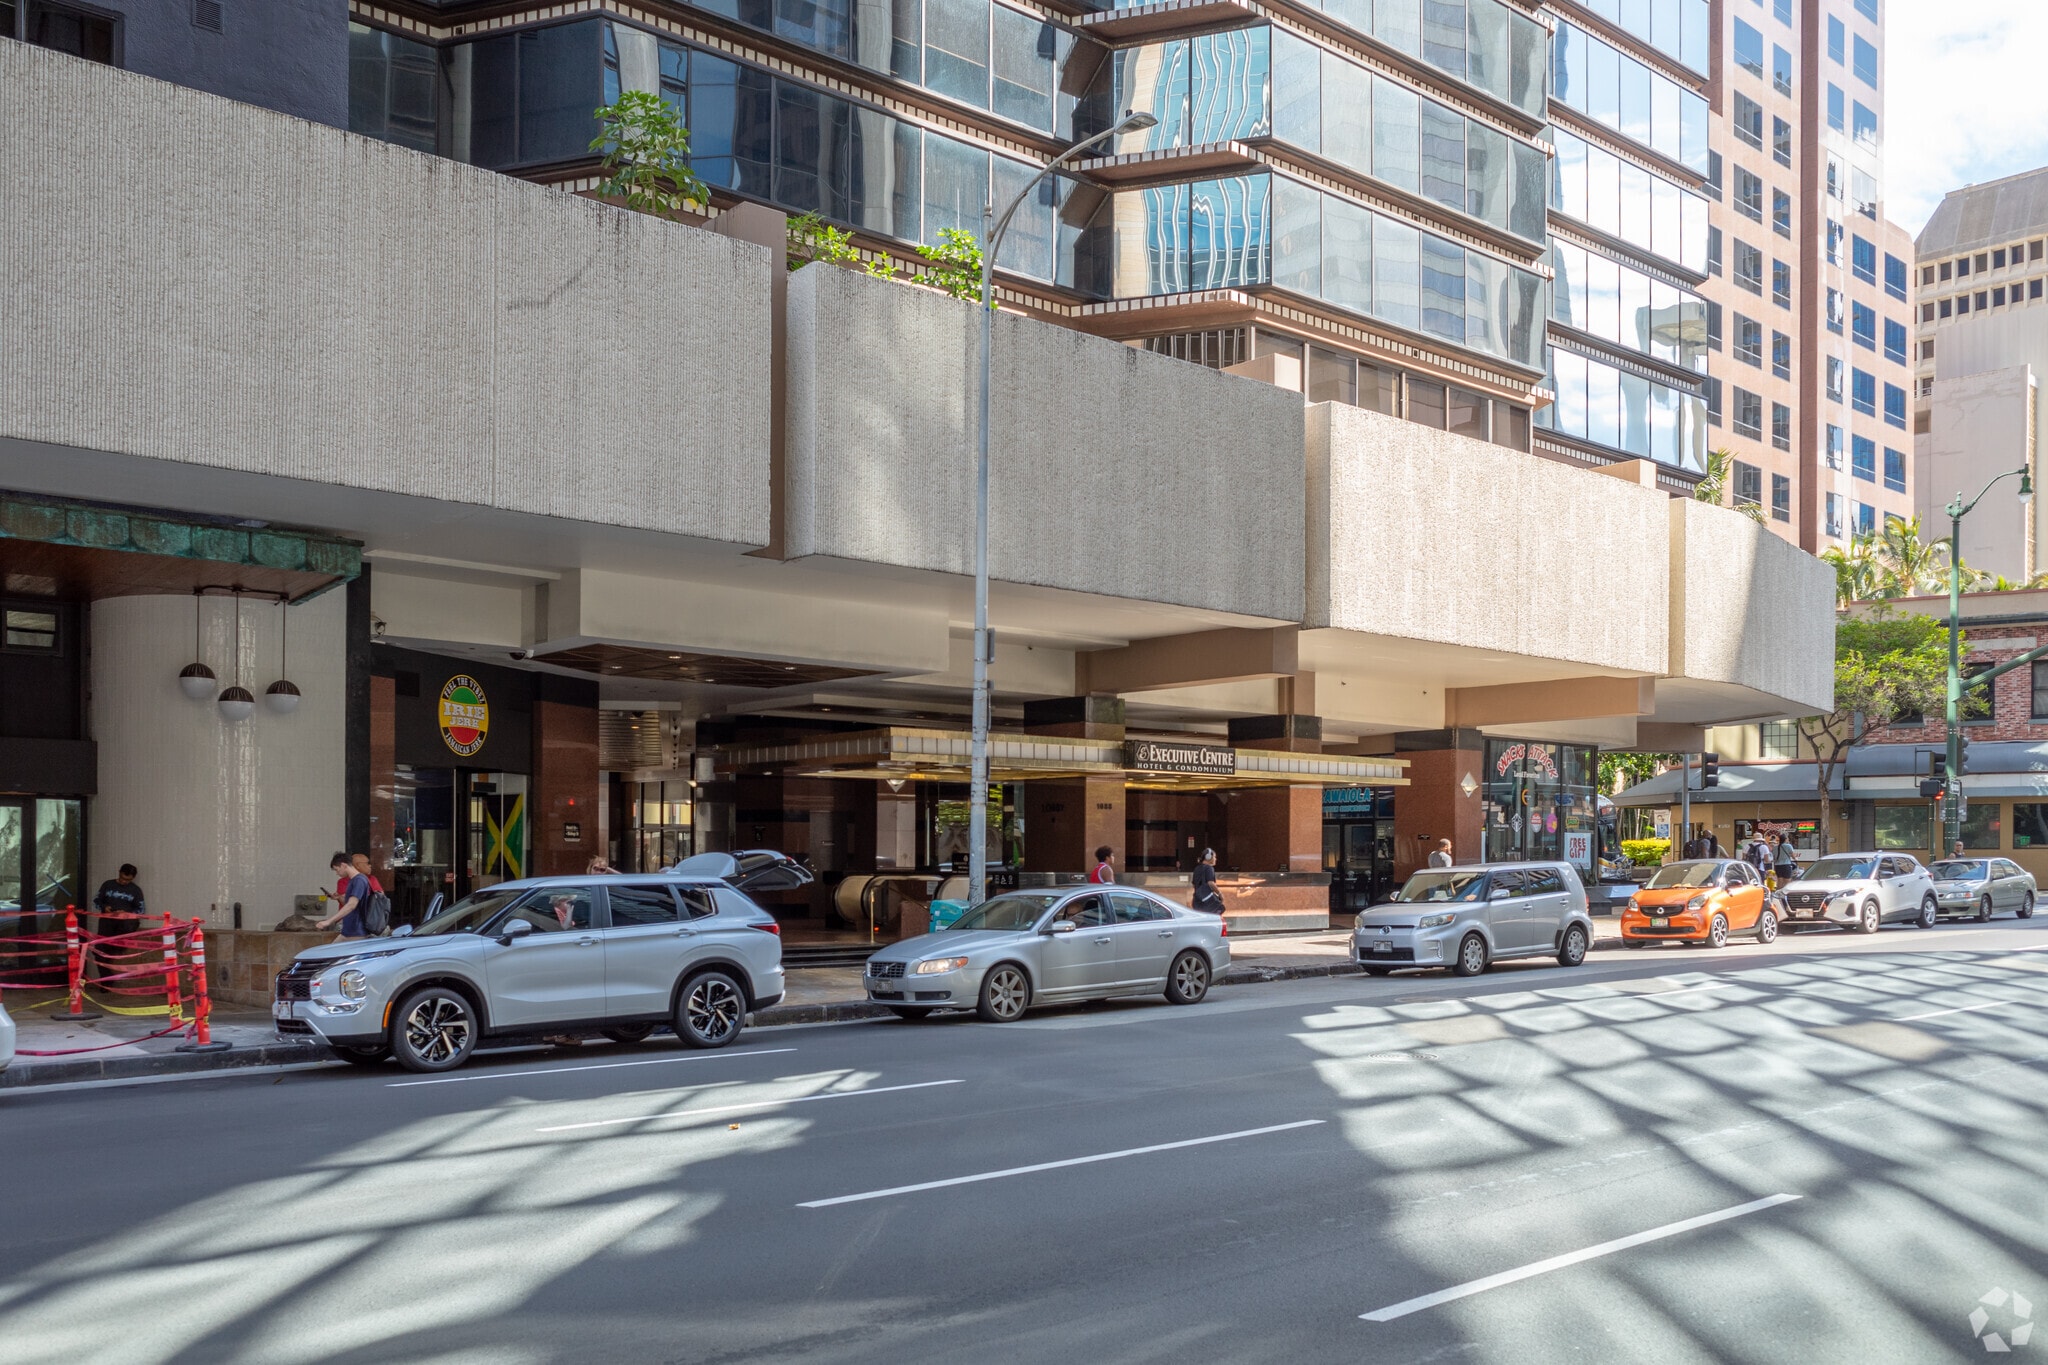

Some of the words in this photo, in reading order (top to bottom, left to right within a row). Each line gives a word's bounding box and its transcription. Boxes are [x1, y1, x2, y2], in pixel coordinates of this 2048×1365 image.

[457, 677, 468, 686] THE
[443, 702, 485, 720] IRIE
[449, 716, 479, 728] JERK
[445, 733, 469, 754] JAMAICAN
[1497, 743, 1526, 777] SNACKS
[1527, 745, 1559, 779] ATTACK
[1175, 764, 1234, 774] CONDOMINIUM
[1323, 787, 1372, 803] AWAIOLA
[1569, 837, 1587, 849] FREE
[1569, 848, 1587, 859] GIFT
